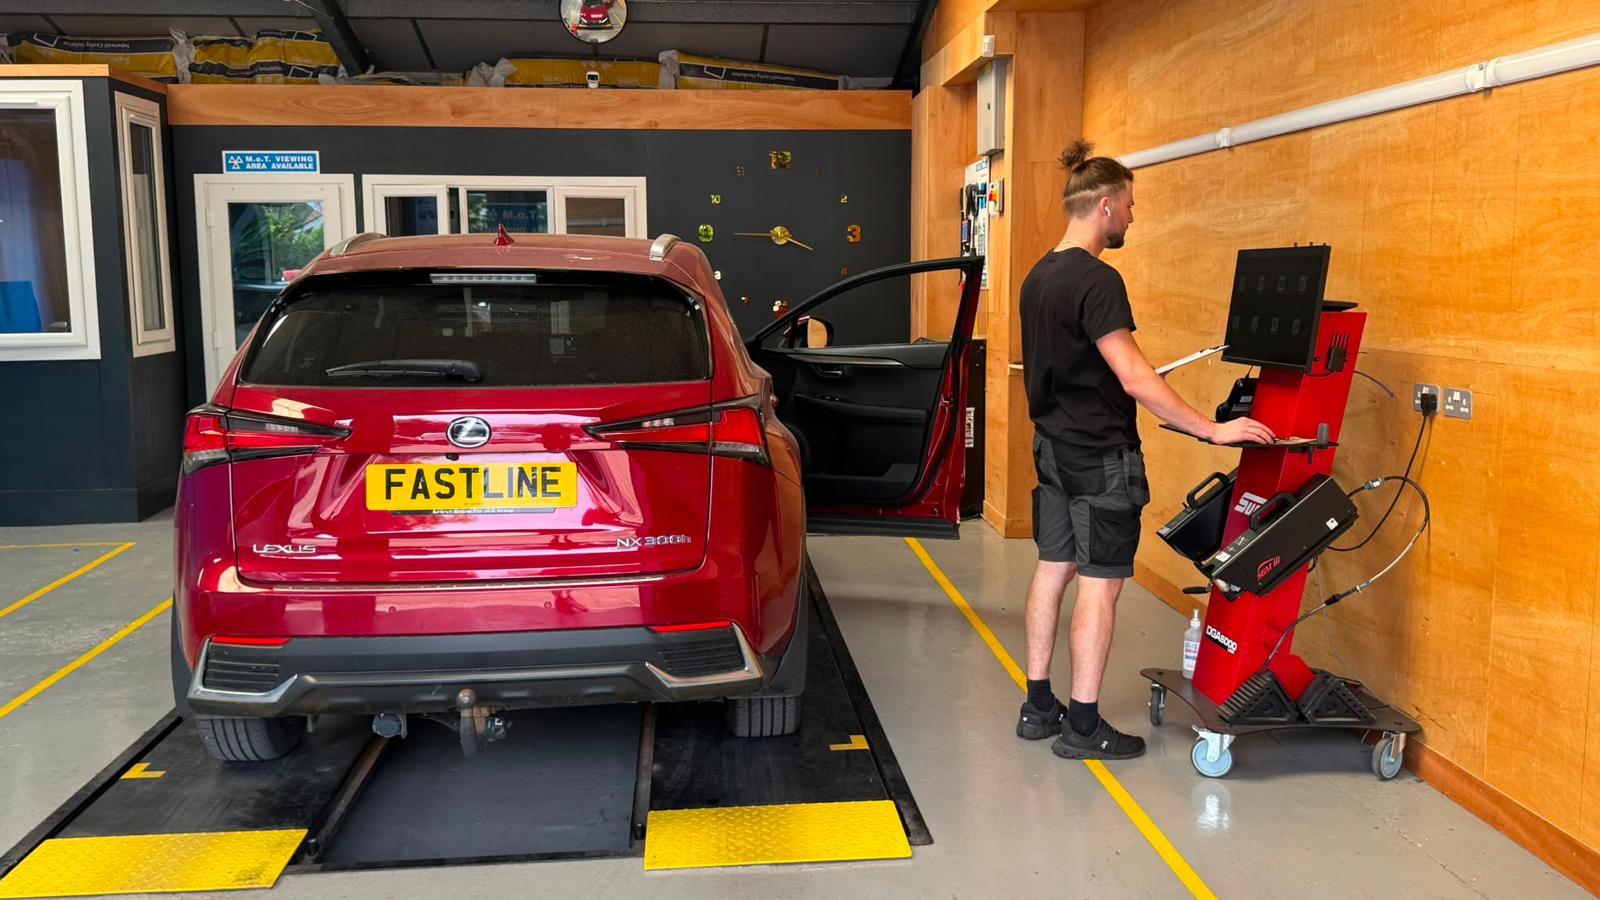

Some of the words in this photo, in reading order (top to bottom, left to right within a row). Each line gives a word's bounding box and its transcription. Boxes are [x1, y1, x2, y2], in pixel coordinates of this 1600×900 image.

[769, 151, 793, 170] 12
[710, 194, 721, 204] 10
[840, 195, 848, 203] 2
[698, 224, 714, 242] 9
[847, 224, 862, 243] 3
[385, 466, 561, 500] FASTLINE
[252, 544, 317, 554] LEXUS
[616, 537, 642, 548] NX
